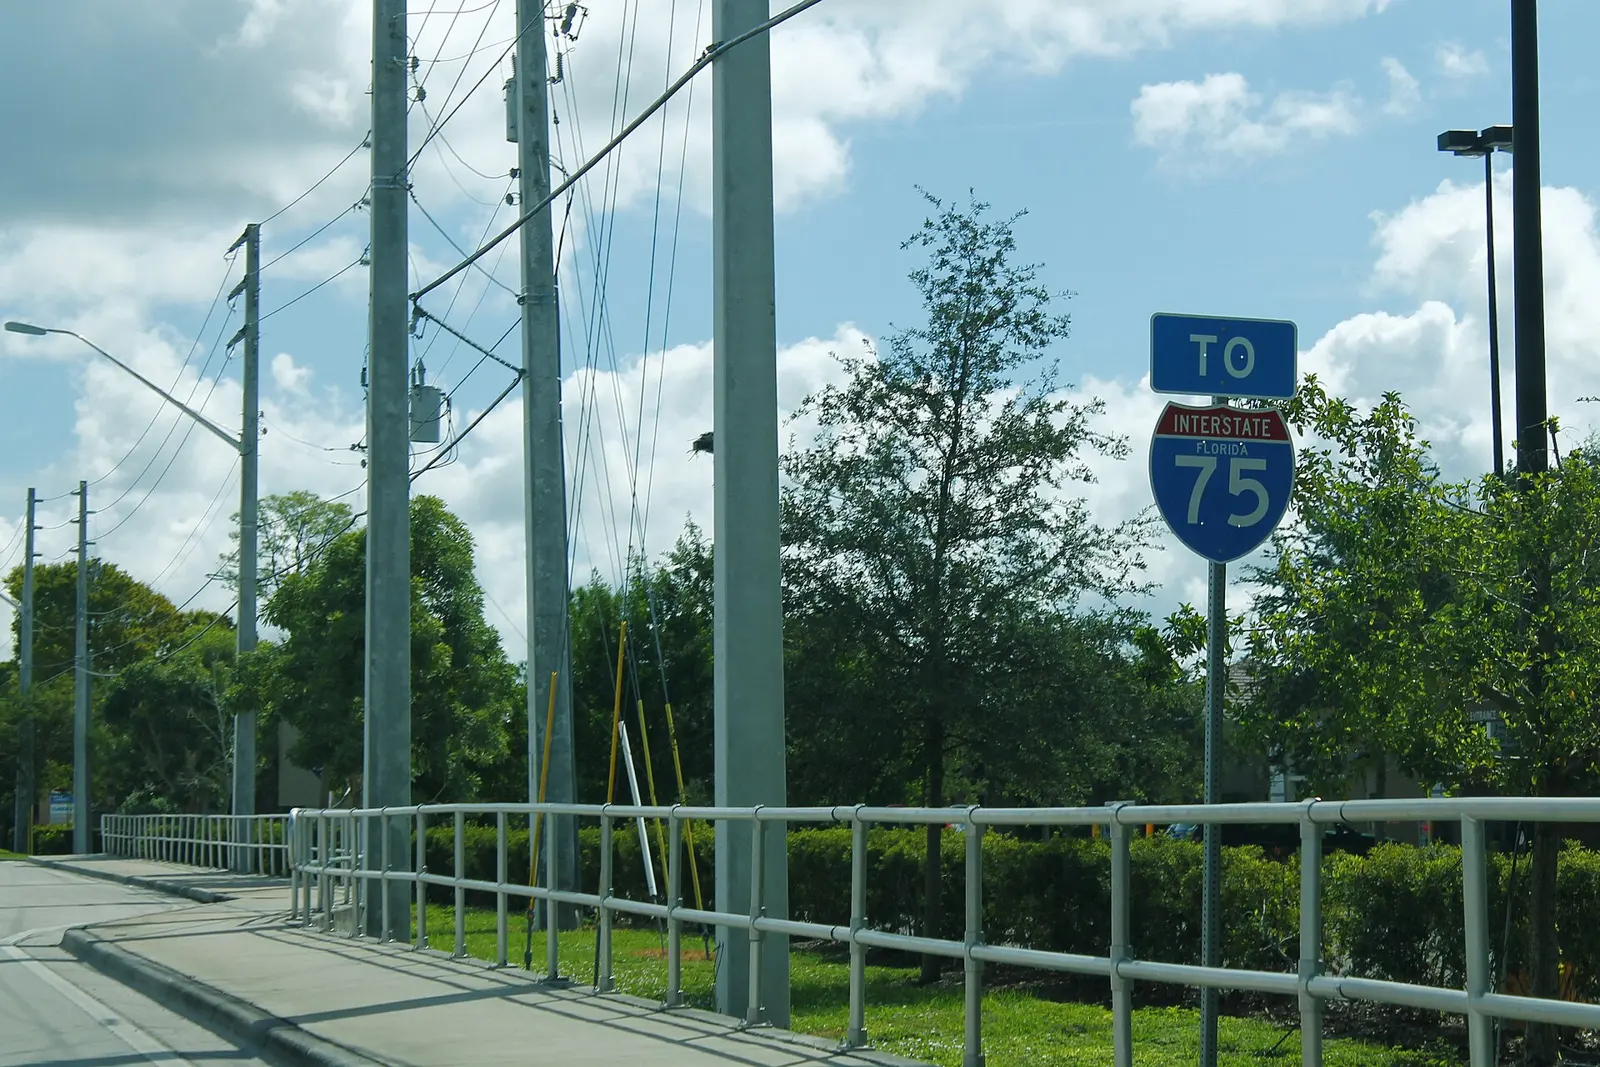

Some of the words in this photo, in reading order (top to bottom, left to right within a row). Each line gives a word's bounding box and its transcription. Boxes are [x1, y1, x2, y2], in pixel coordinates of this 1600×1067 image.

[1190, 334, 1255, 378] TO
[1174, 415, 1271, 437] INTERSTATE
[1197, 443, 1248, 456] FLORIDA
[1175, 455, 1269, 528] 75
